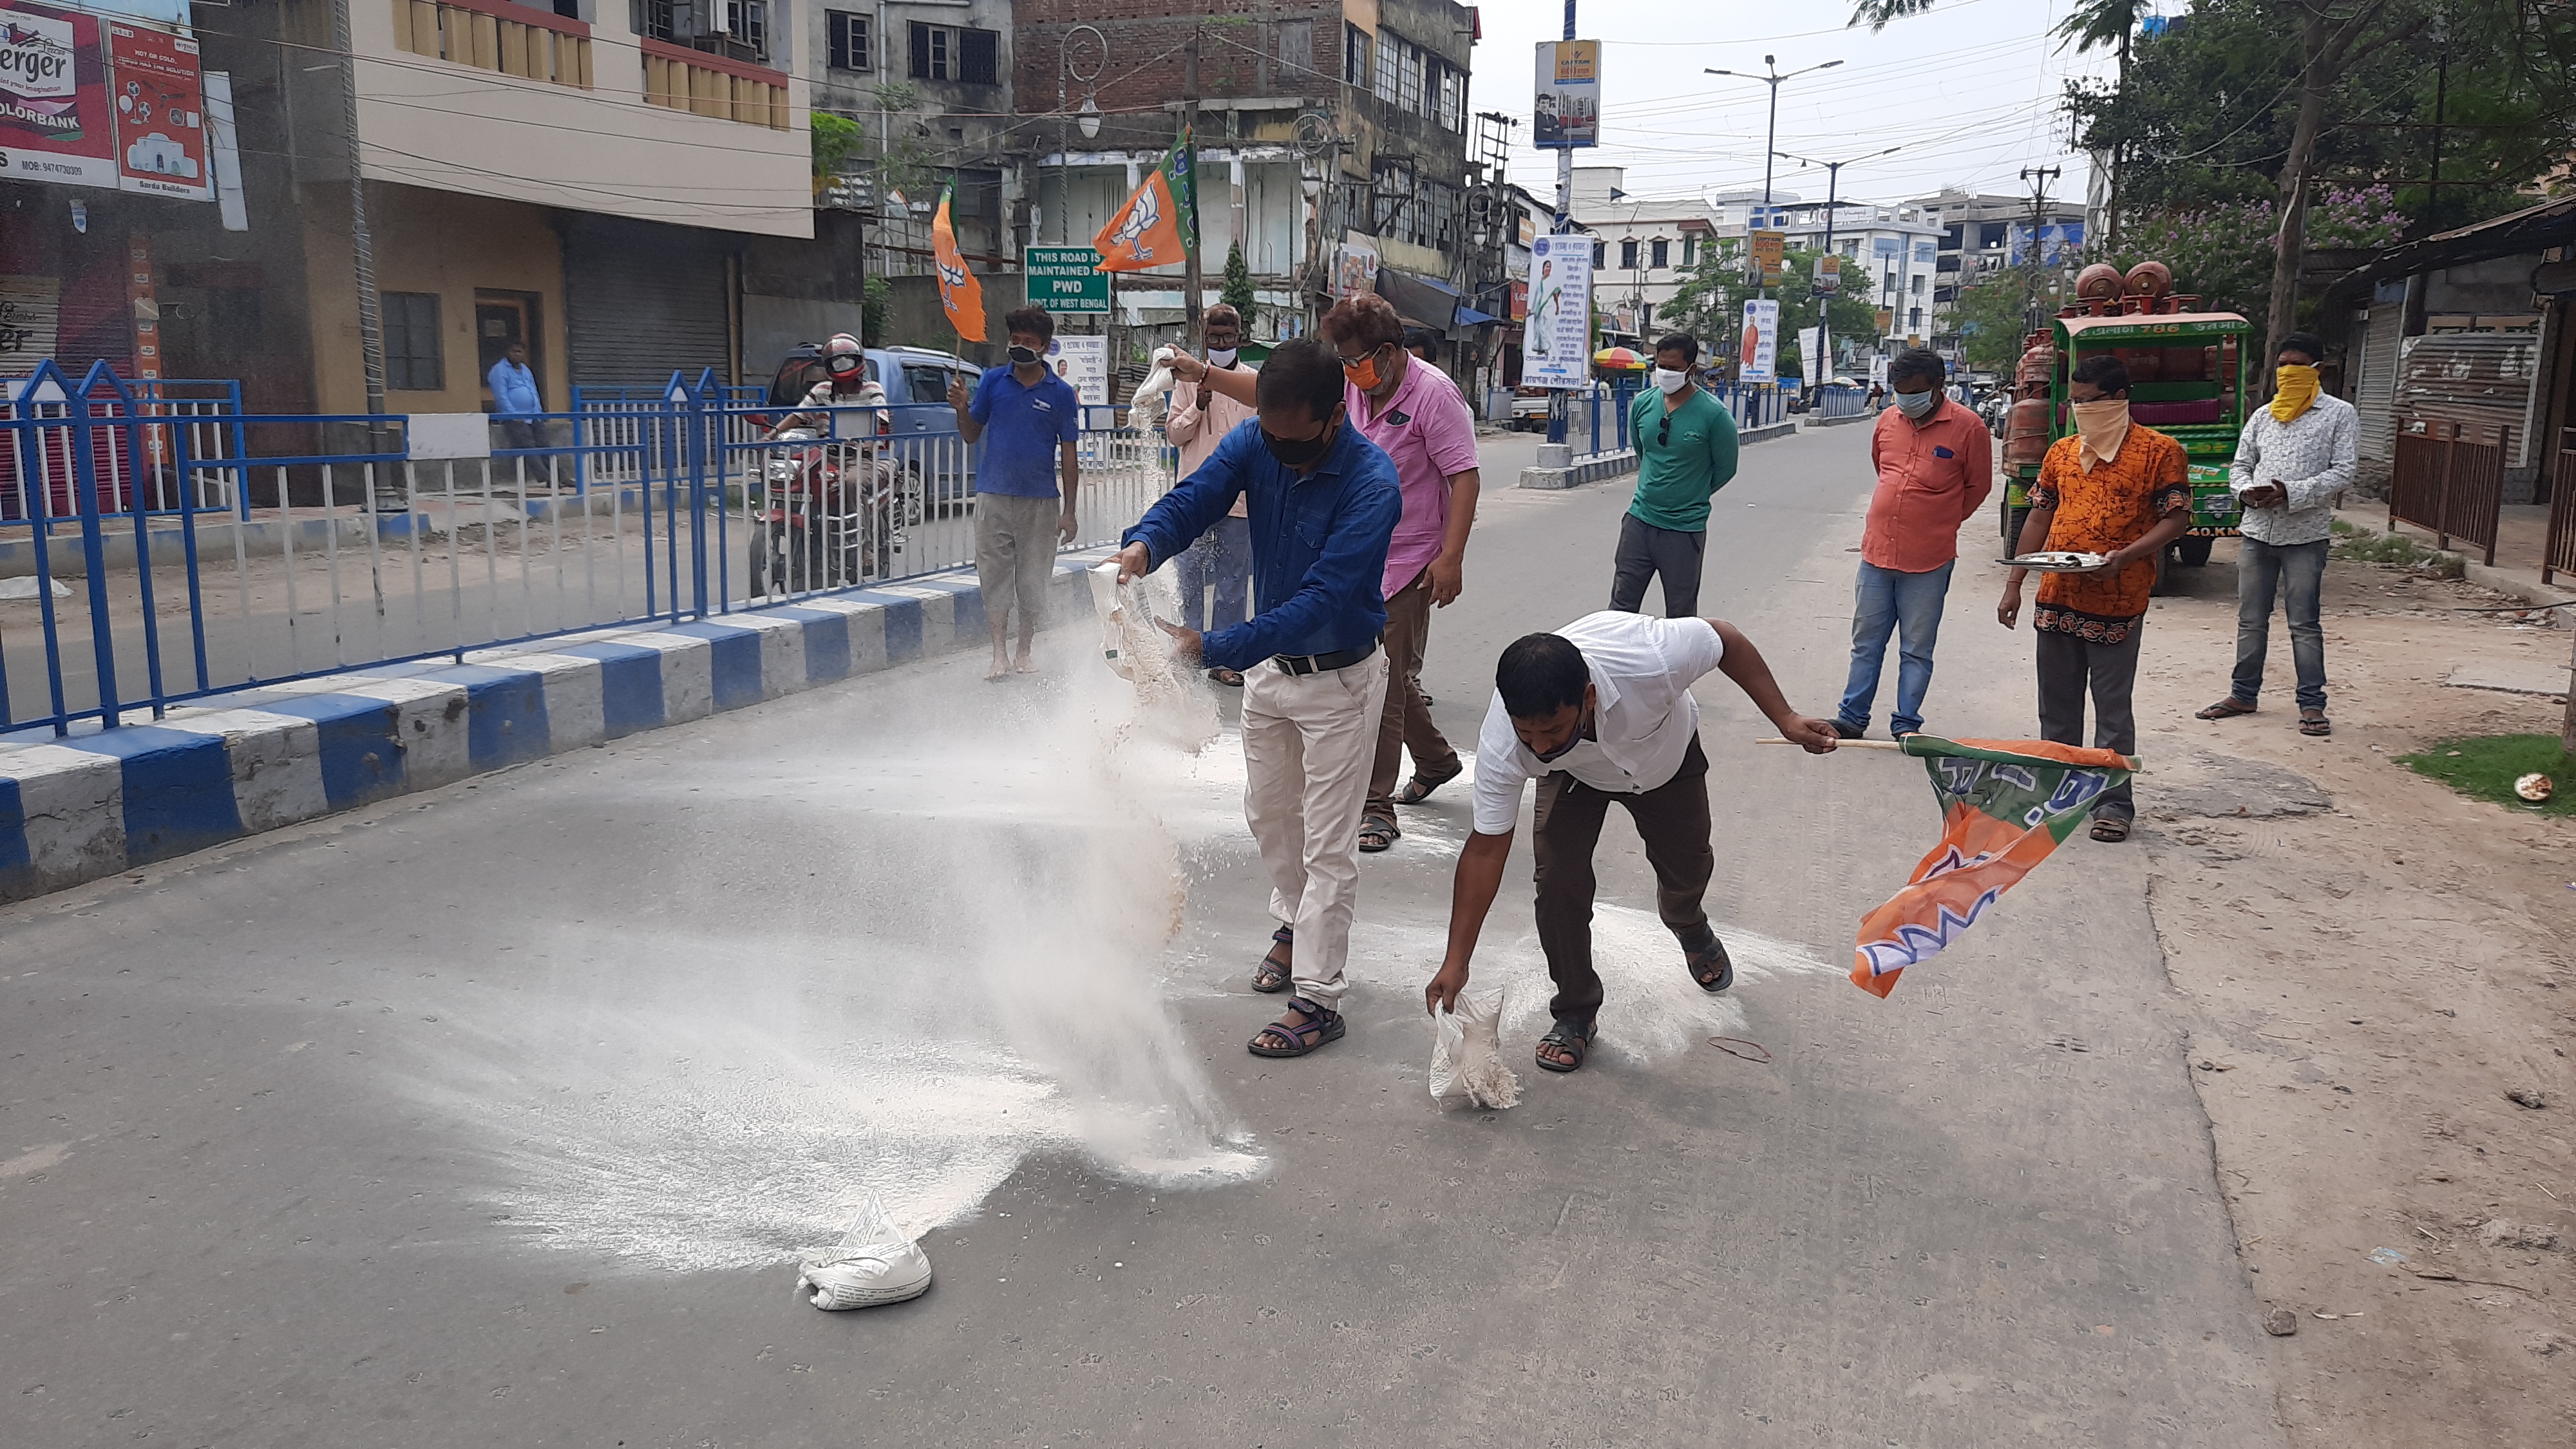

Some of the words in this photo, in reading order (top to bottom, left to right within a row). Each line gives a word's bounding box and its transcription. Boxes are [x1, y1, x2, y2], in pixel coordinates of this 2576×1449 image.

[1034, 252, 1058, 263] THIS
[1060, 252, 1088, 263] ROAD
[1091, 252, 1101, 263] IS
[1028, 266, 1090, 276] MAINTAINED
[1053, 280, 1083, 293] PWD
[1050, 299, 1059, 308] OF
[1060, 299, 1079, 308] WEST
[1080, 298, 1107, 308] BENGAL
[2140, 325, 2180, 334] 786
[1550, 375, 1580, 386] পৌরসভা
